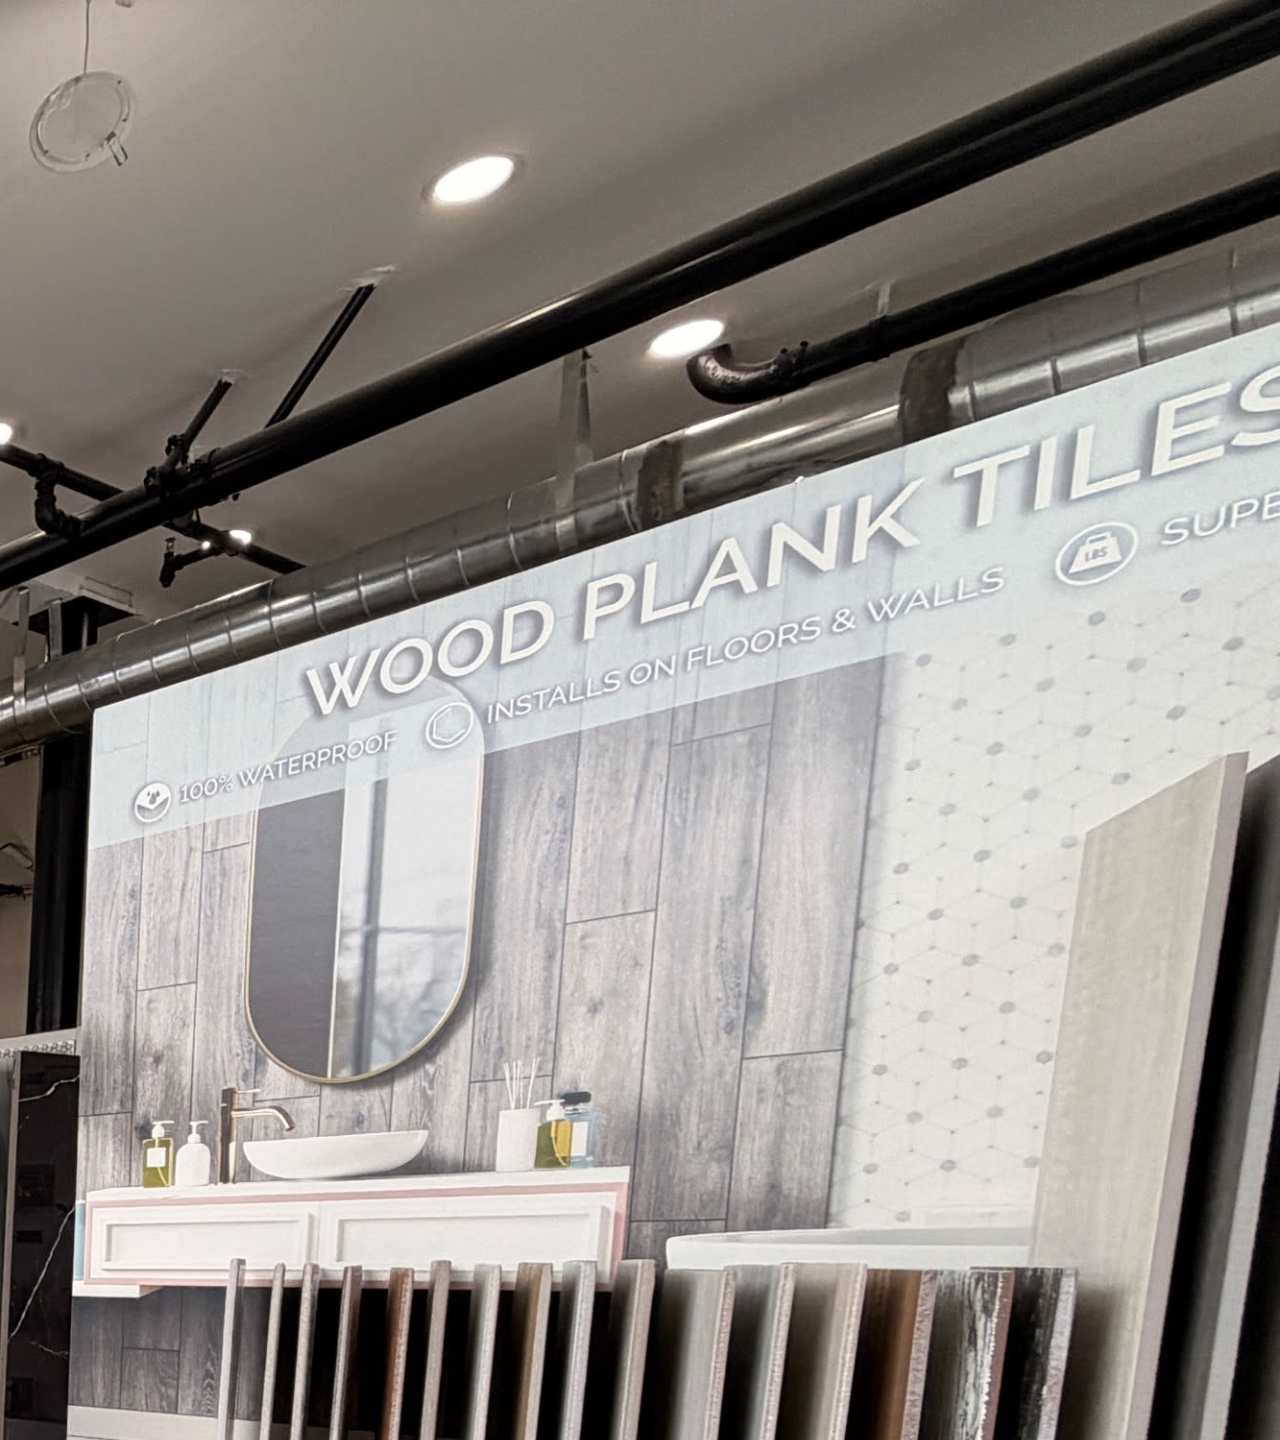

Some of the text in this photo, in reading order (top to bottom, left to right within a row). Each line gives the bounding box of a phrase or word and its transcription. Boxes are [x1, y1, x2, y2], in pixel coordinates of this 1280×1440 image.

[305, 365, 1280, 716] WOOD PLANK TILES
[486, 566, 1007, 724] INSTALLS ON FLOORS & WALLS
[179, 730, 399, 803] 100% WATERPROOF
